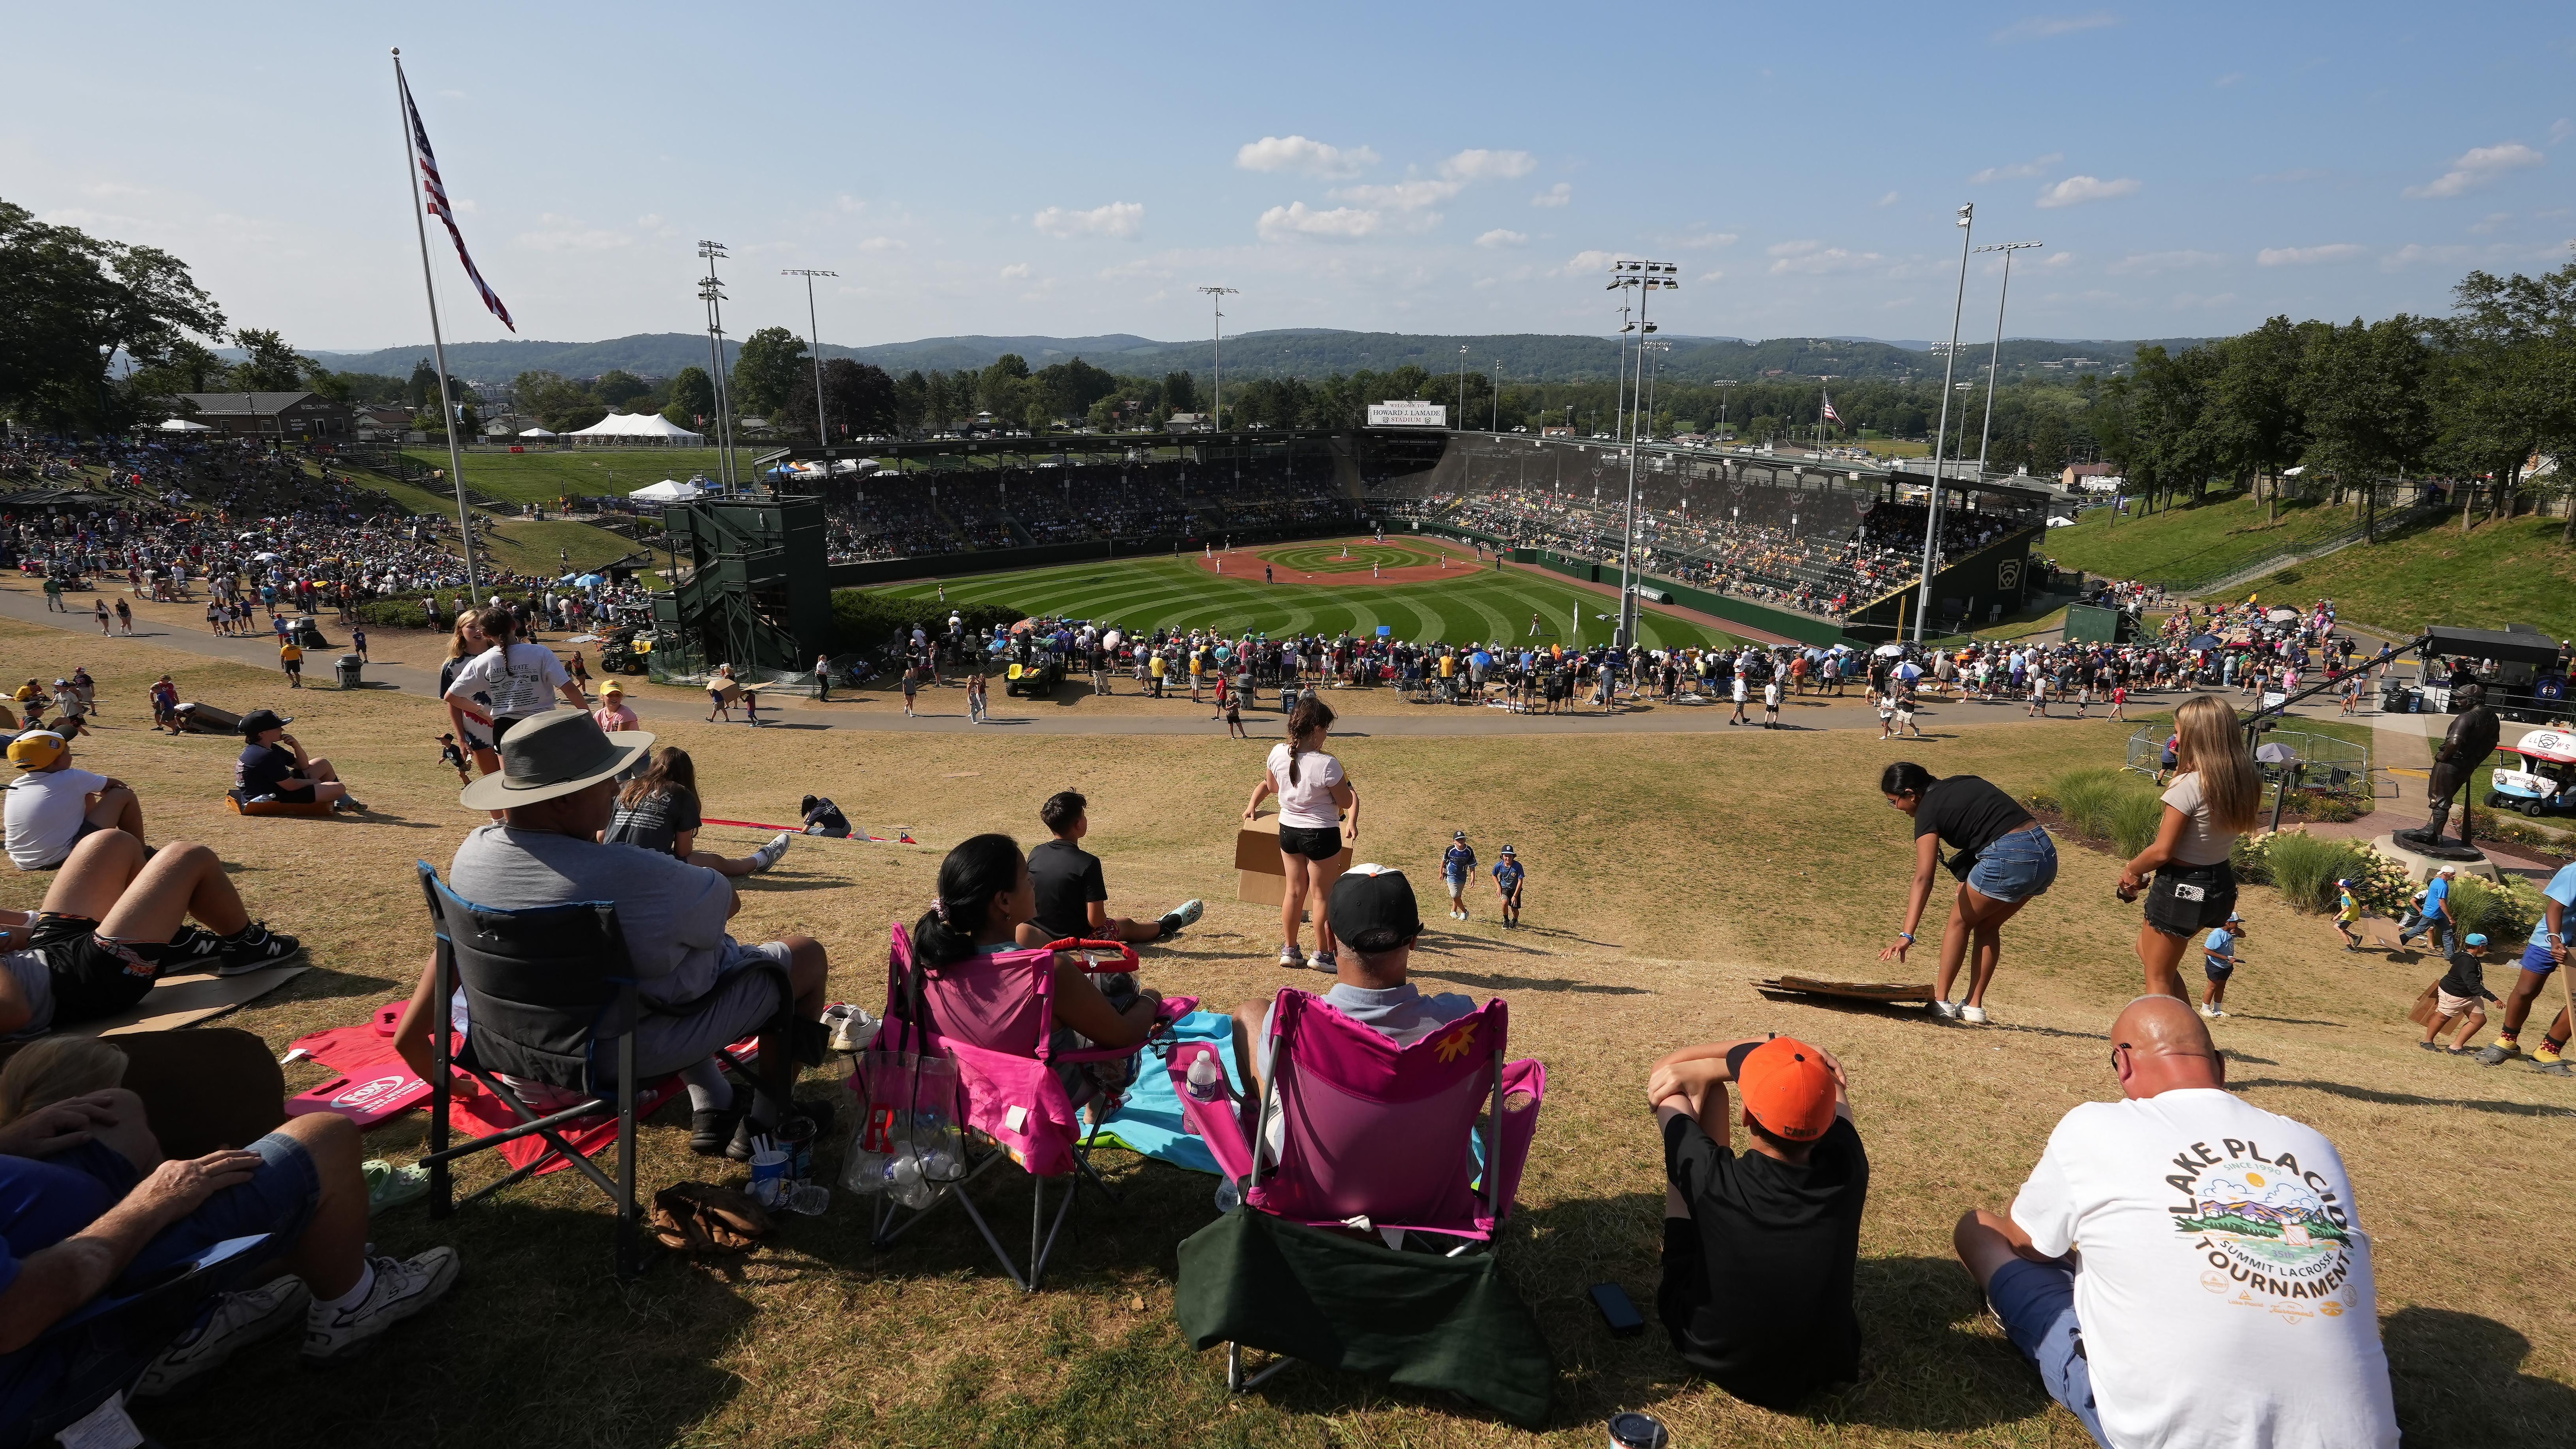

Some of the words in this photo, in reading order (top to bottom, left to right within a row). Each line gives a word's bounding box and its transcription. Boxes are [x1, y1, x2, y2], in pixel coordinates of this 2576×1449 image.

[193, 940, 216, 954] N
[266, 941, 281, 956] N
[342, 1082, 386, 1102] FOX
[355, 1082, 395, 1102] SPORTS
[355, 1098, 384, 1112] NEW
[384, 1077, 423, 1099] JERSEY
[864, 1103, 895, 1154] R
[2223, 1162, 2252, 1171] SINCE
[2255, 1163, 2281, 1175] 1990
[2165, 1142, 2223, 1215] LAKE
[2223, 1138, 2348, 1230] PLACID
[2219, 1240, 2274, 1273] SUMMIT
[2279, 1251, 2334, 1277] LACROSSE
[2272, 1249, 2295, 1259] 35th
[2195, 1236, 2351, 1299] TOURNAMENT
